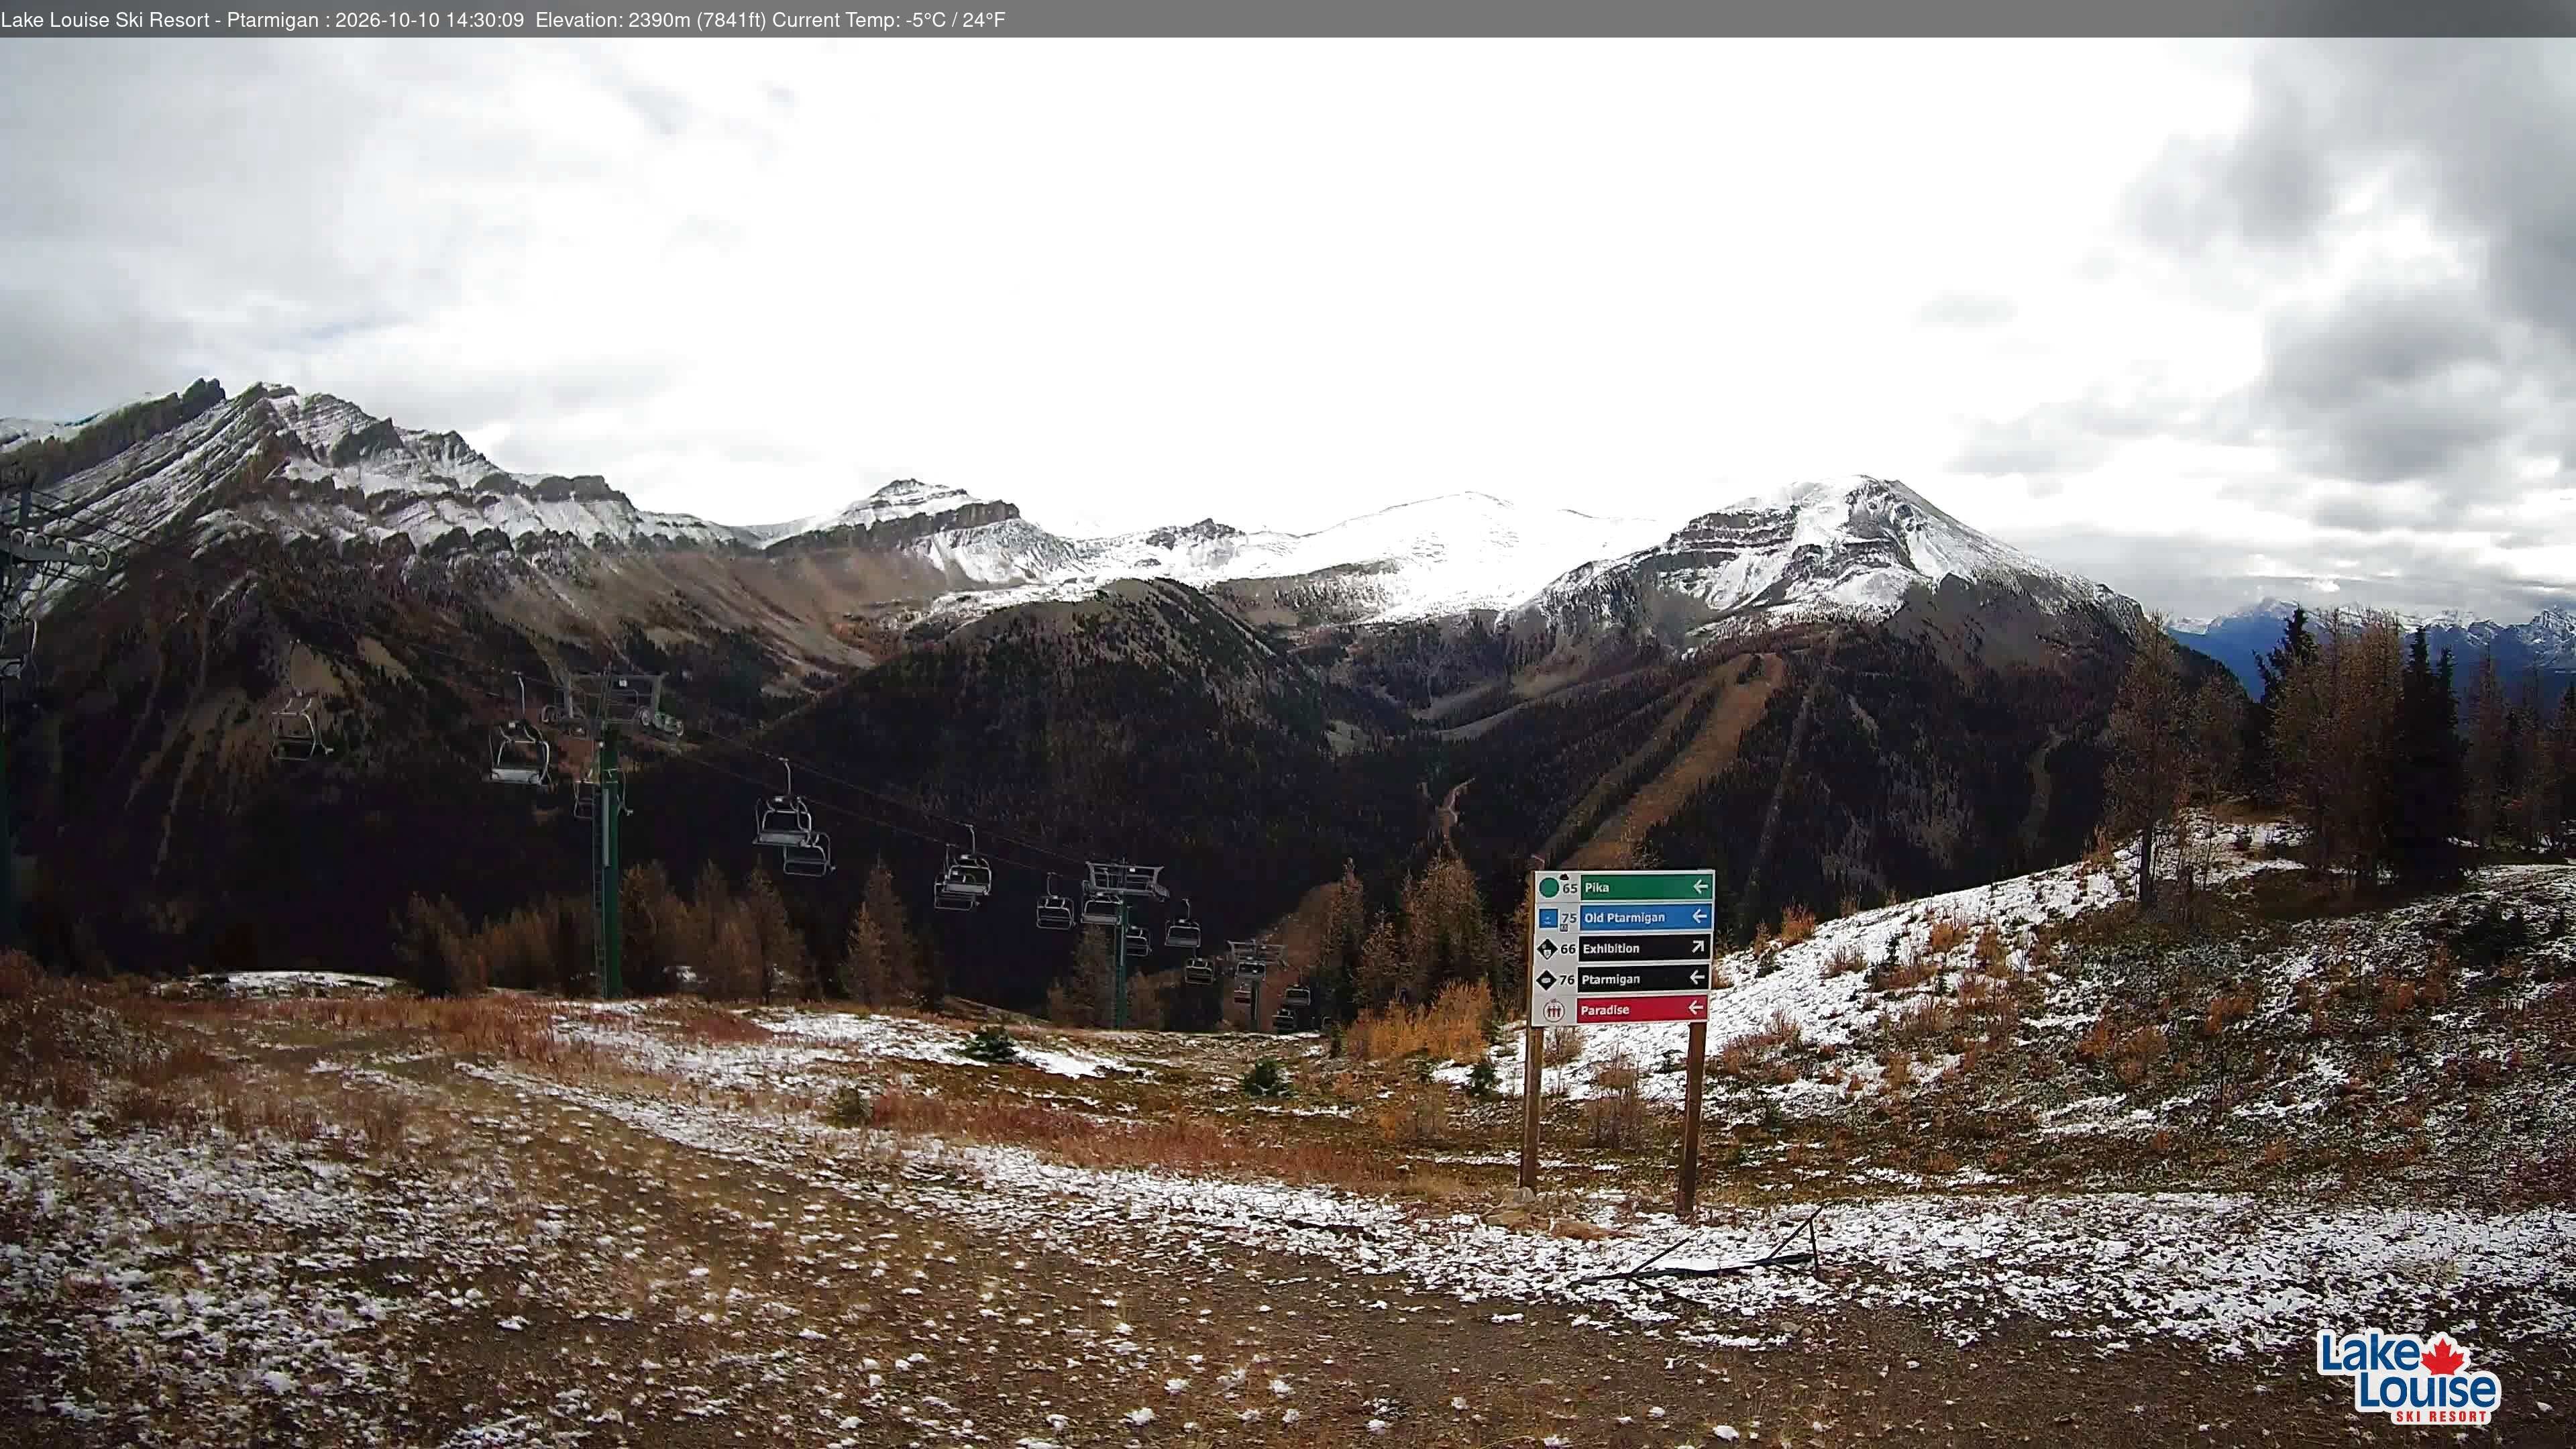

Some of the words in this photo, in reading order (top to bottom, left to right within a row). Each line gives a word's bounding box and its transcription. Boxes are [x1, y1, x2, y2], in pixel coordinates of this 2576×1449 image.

[1562, 883, 1578, 894] 65
[1585, 882, 1609, 893] Pika
[1562, 913, 1577, 924] 75
[1585, 912, 1604, 923] Old
[1607, 912, 1666, 924] Ptarmigan
[1560, 944, 1576, 955] 66
[1583, 943, 1640, 954] Exhibition
[1559, 975, 1575, 985] 76
[1582, 974, 1640, 985] Ptarmigan
[1580, 1004, 1630, 1016] Paradise
